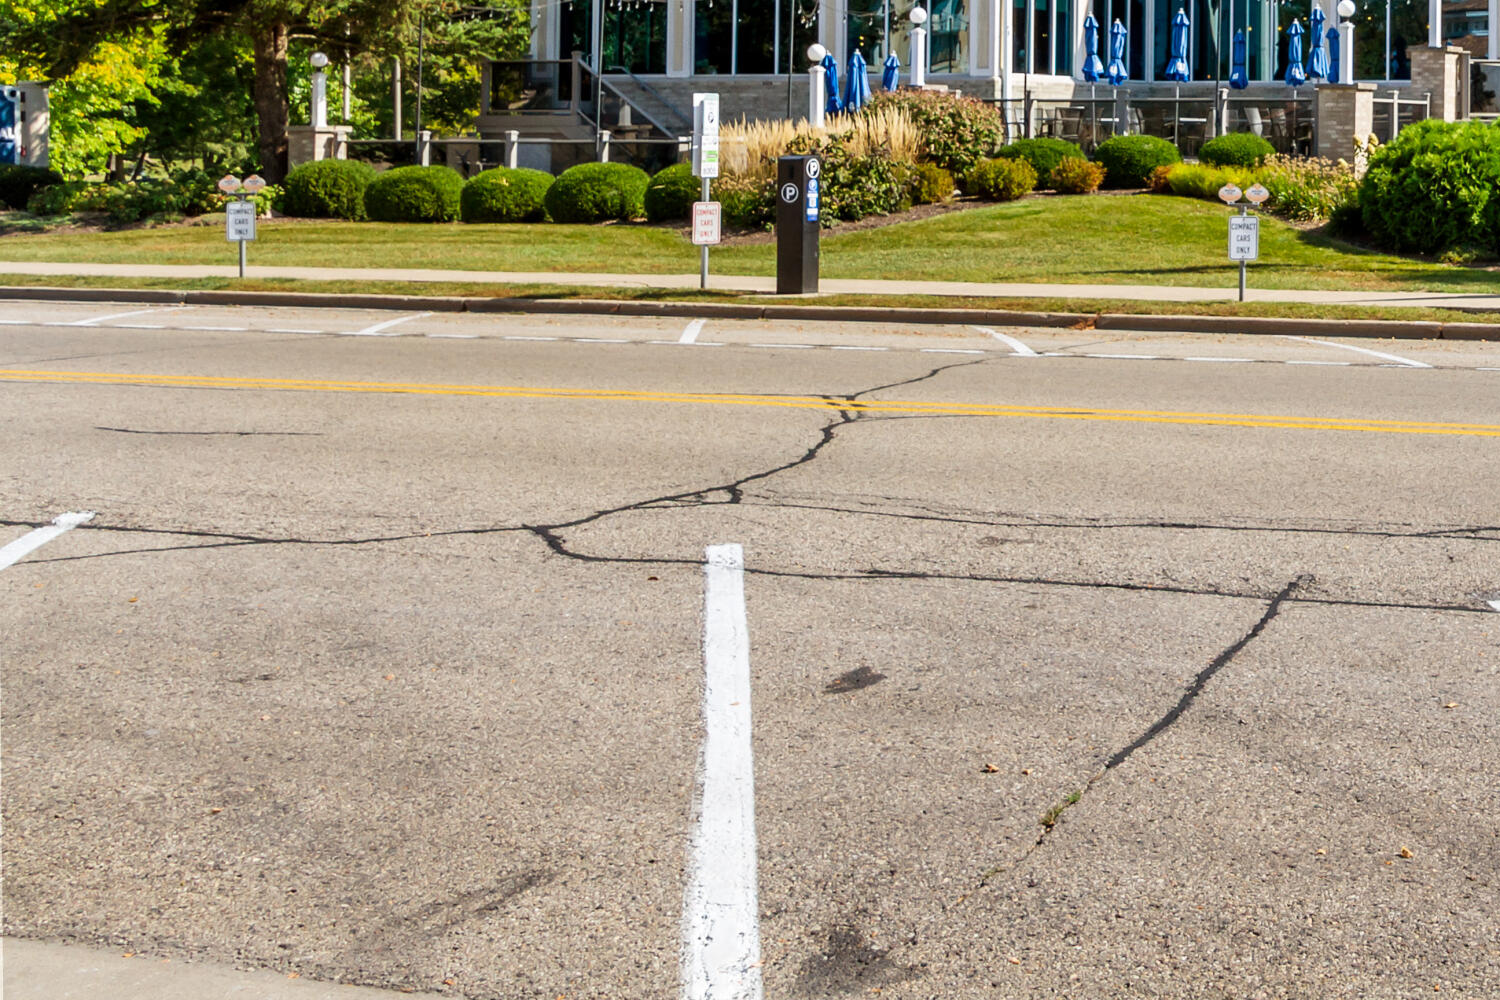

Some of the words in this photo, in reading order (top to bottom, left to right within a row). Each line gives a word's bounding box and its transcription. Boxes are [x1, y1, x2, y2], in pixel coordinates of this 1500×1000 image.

[1231, 222, 1256, 231] COMPACT
[1236, 234, 1250, 242] CARS
[1236, 246, 1250, 254] ONLY
